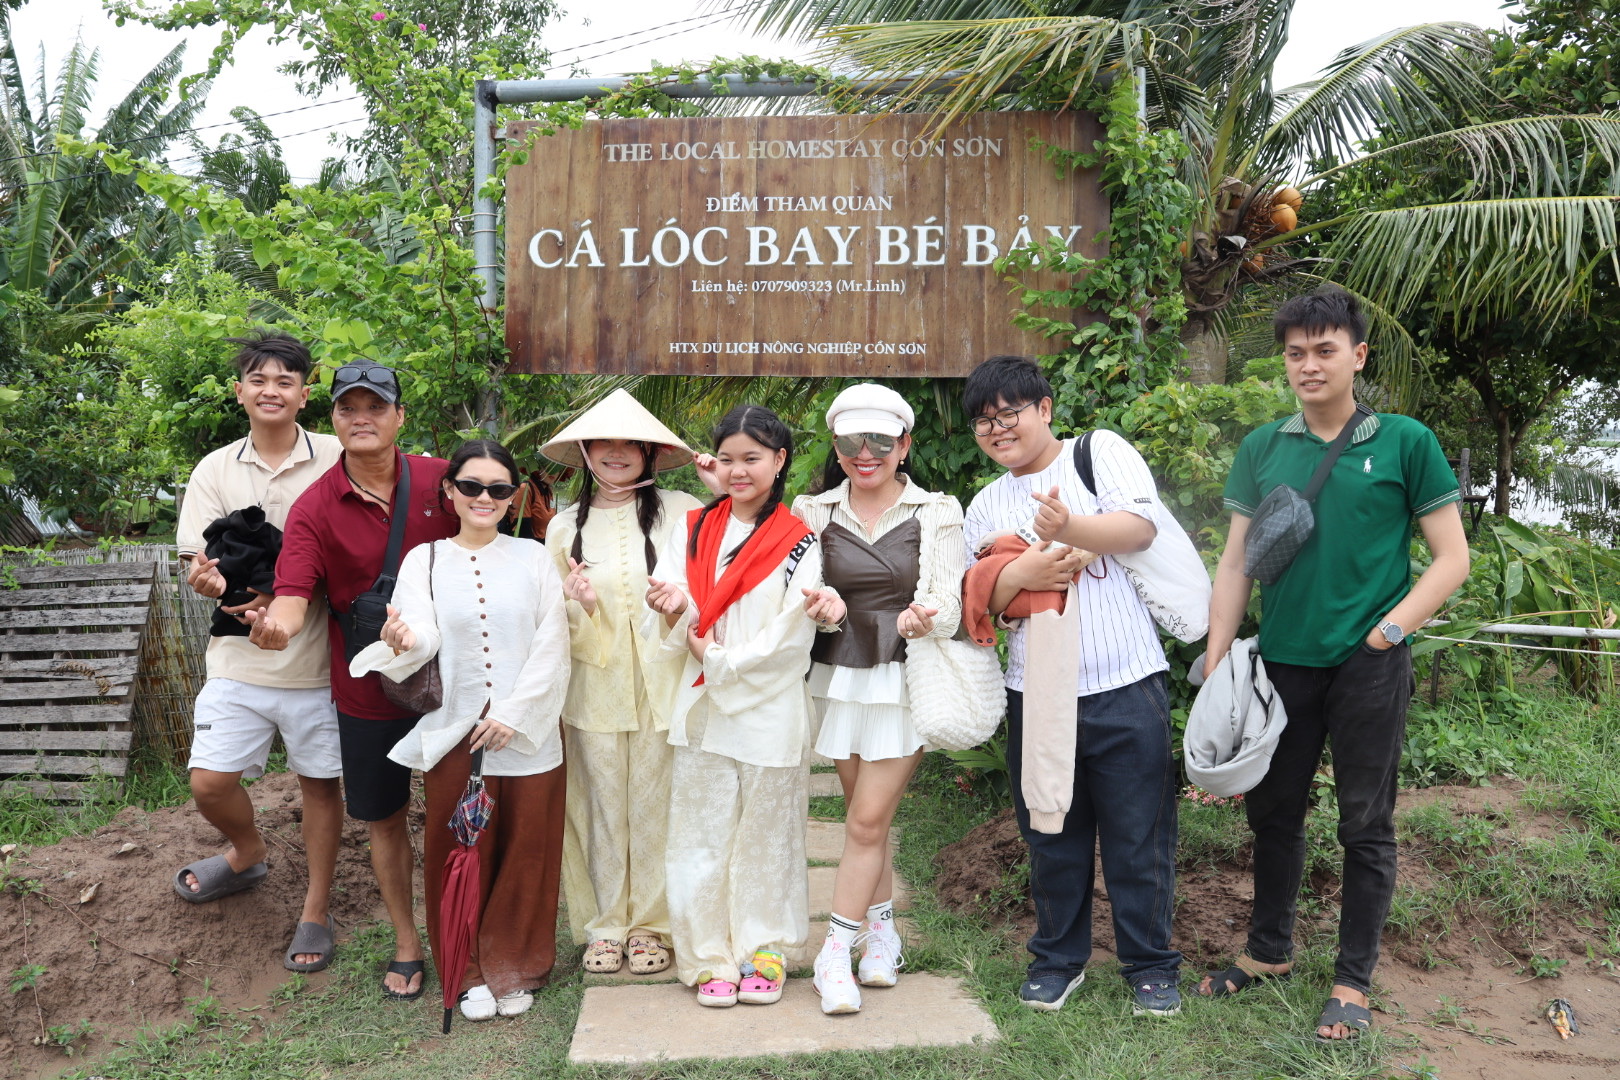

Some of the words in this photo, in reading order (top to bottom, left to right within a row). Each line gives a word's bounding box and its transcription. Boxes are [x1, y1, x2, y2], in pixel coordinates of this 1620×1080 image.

[603, 143, 653, 162] THE
[659, 141, 741, 161] LOCAL
[746, 138, 886, 159] HOMESTAY
[952, 135, 1003, 157] SƠN
[705, 191, 759, 213] ĐIỂM
[763, 195, 828, 213] THAM
[832, 195, 893, 216] QUAN
[528, 218, 606, 269] CÁ
[618, 216, 729, 268] LÓC
[744, 225, 861, 266] BAY
[874, 215, 946, 266] BÉ
[961, 214, 1083, 266] BẢY
[691, 279, 723, 293] Liên
[726, 279, 748, 295] hệ:
[751, 280, 833, 293] 0707909323
[836, 279, 906, 296] (Mr.Linh)
[669, 342, 699, 354] HTX
[702, 342, 722, 354] DU
[725, 342, 760, 356] LỊCH
[762, 340, 804, 354] NÔNG
[806, 340, 862, 357] NGHIỆP
